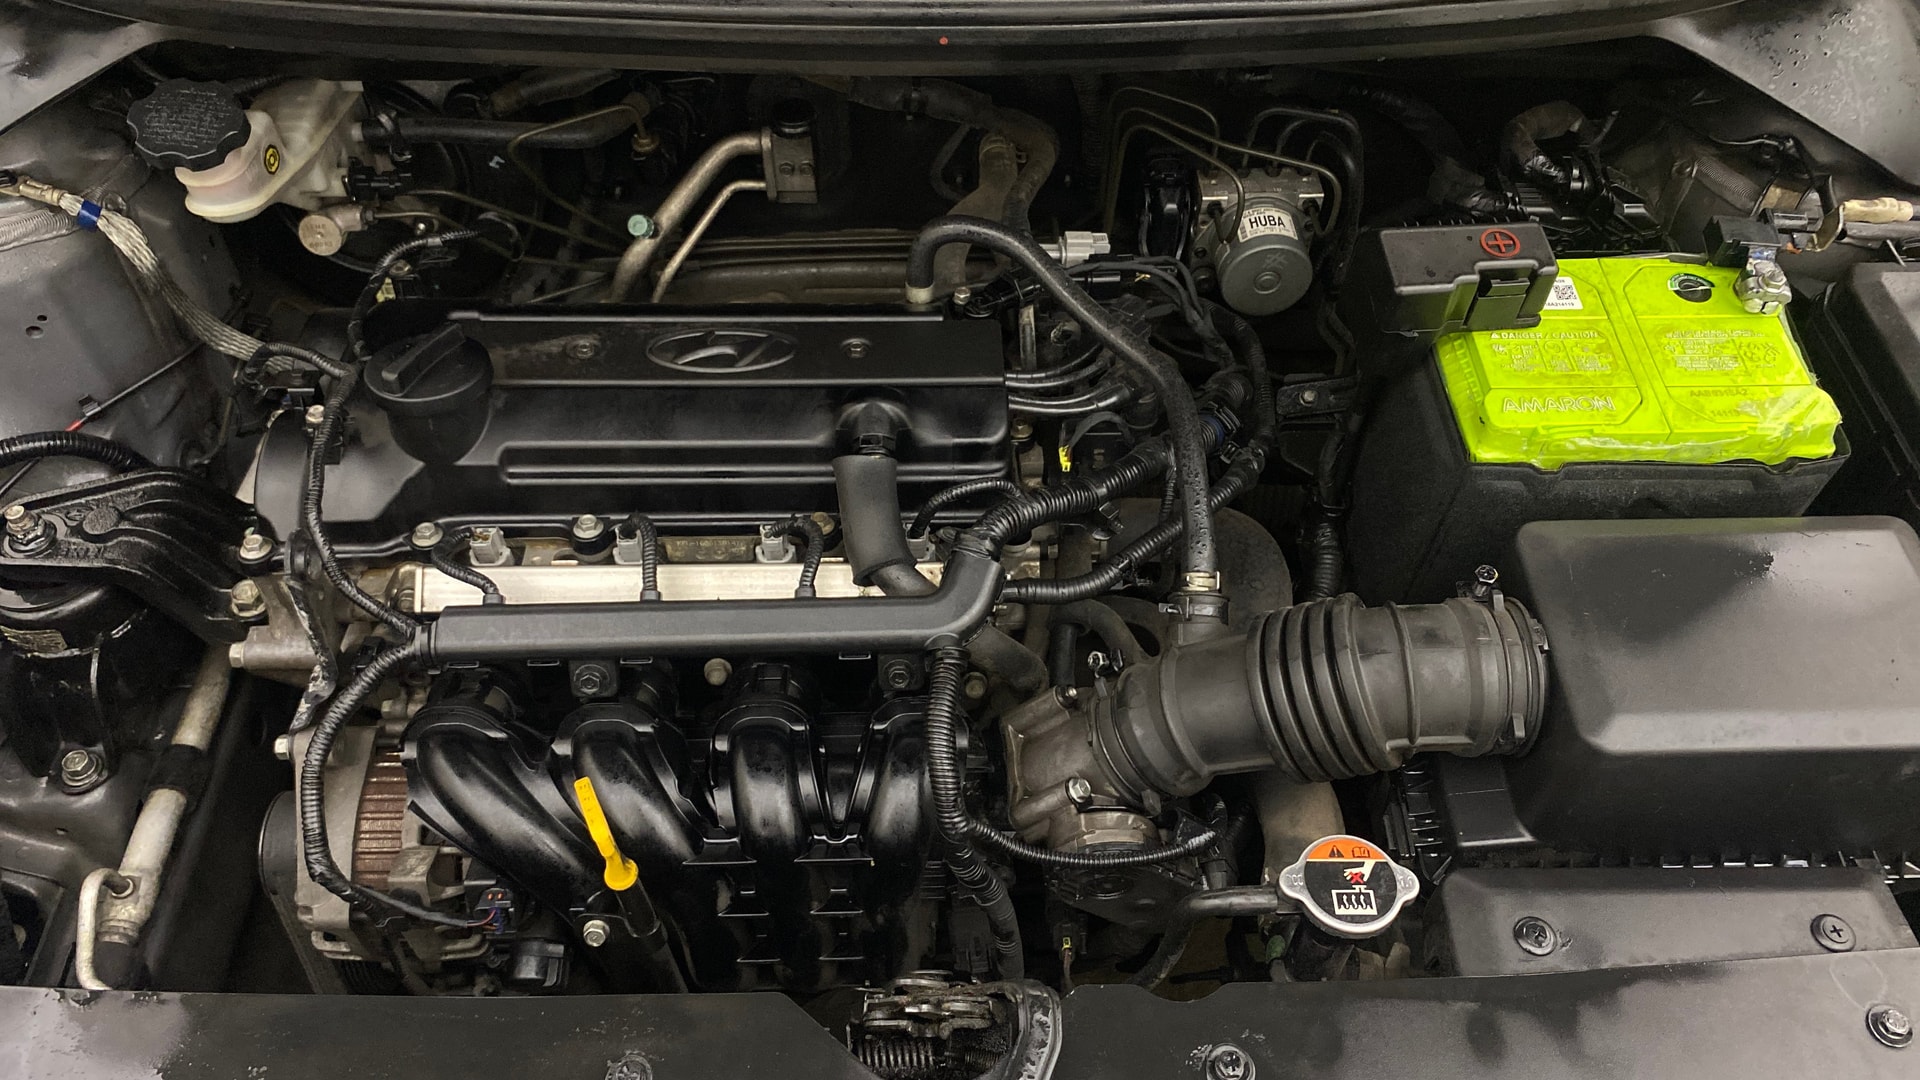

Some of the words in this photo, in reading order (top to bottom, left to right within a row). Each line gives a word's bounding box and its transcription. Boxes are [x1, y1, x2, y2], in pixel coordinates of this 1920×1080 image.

[1248, 215, 1286, 229] HUBA
[1552, 331, 1598, 339] CAUTION
[1503, 396, 1617, 413] AMARON
